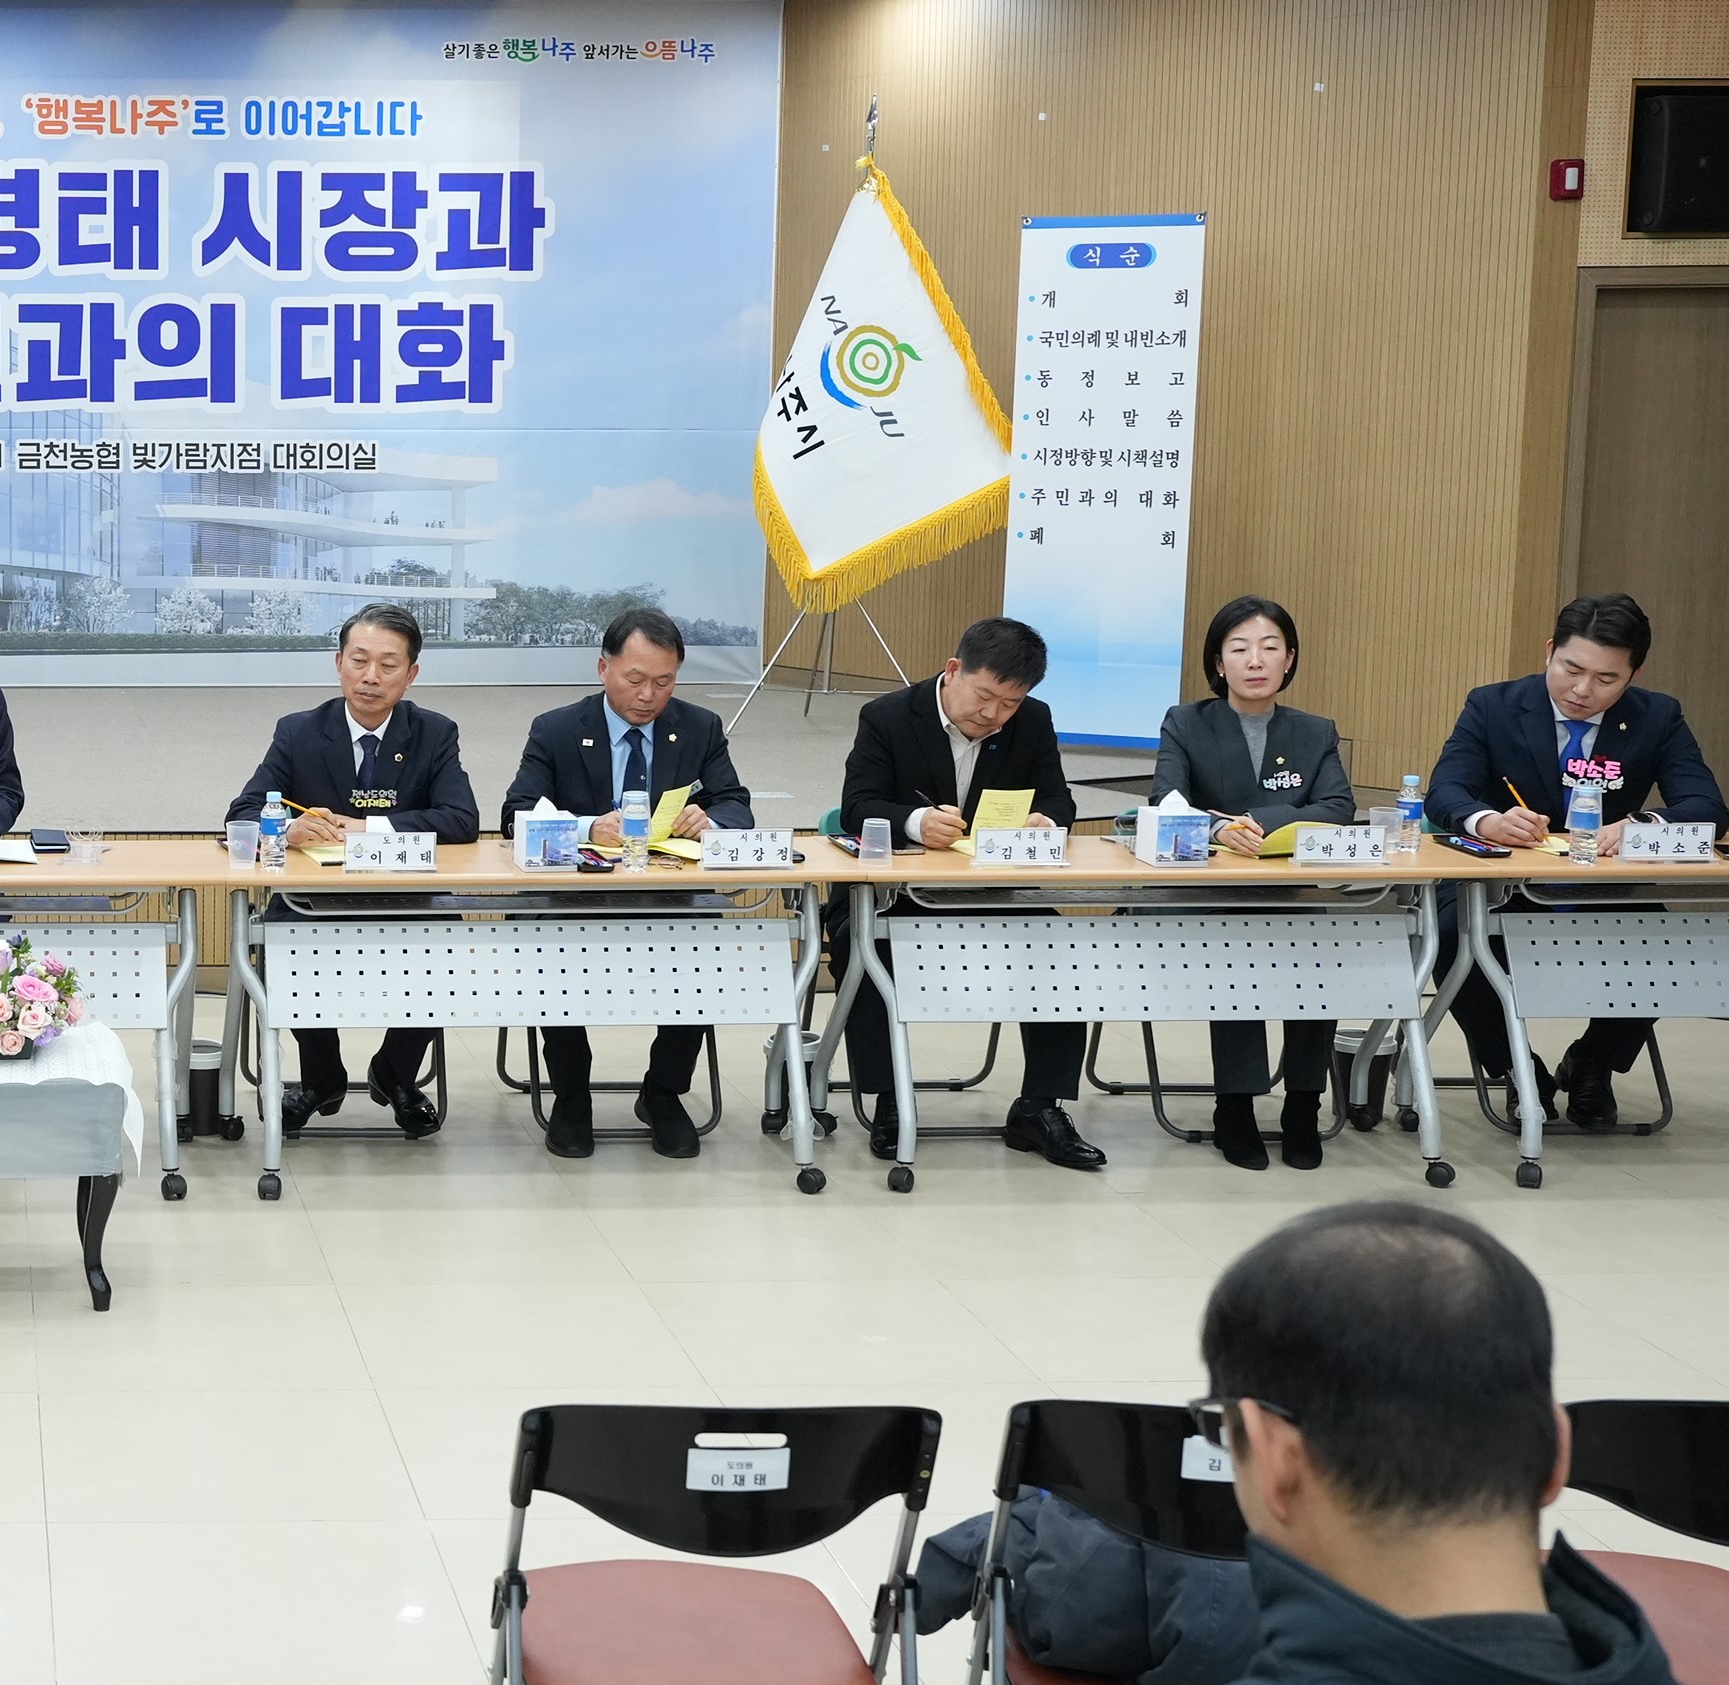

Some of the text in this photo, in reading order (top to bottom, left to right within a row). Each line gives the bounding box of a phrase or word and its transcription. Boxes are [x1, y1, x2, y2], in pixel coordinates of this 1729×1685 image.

[583, 44, 638, 60] 앞서가는
[245, 99, 422, 137] 이어갑니다
[201, 169, 546, 272] 시장과
[280, 301, 506, 404] 대화
[1039, 330, 1187, 349] 국민의례 및 내빈소개
[16, 442, 121, 470] 금천농협
[132, 442, 262, 470] 빛가람지점
[272, 442, 377, 470] 대회의실
[1034, 449, 1180, 468] 시정방향 및 시책설명
